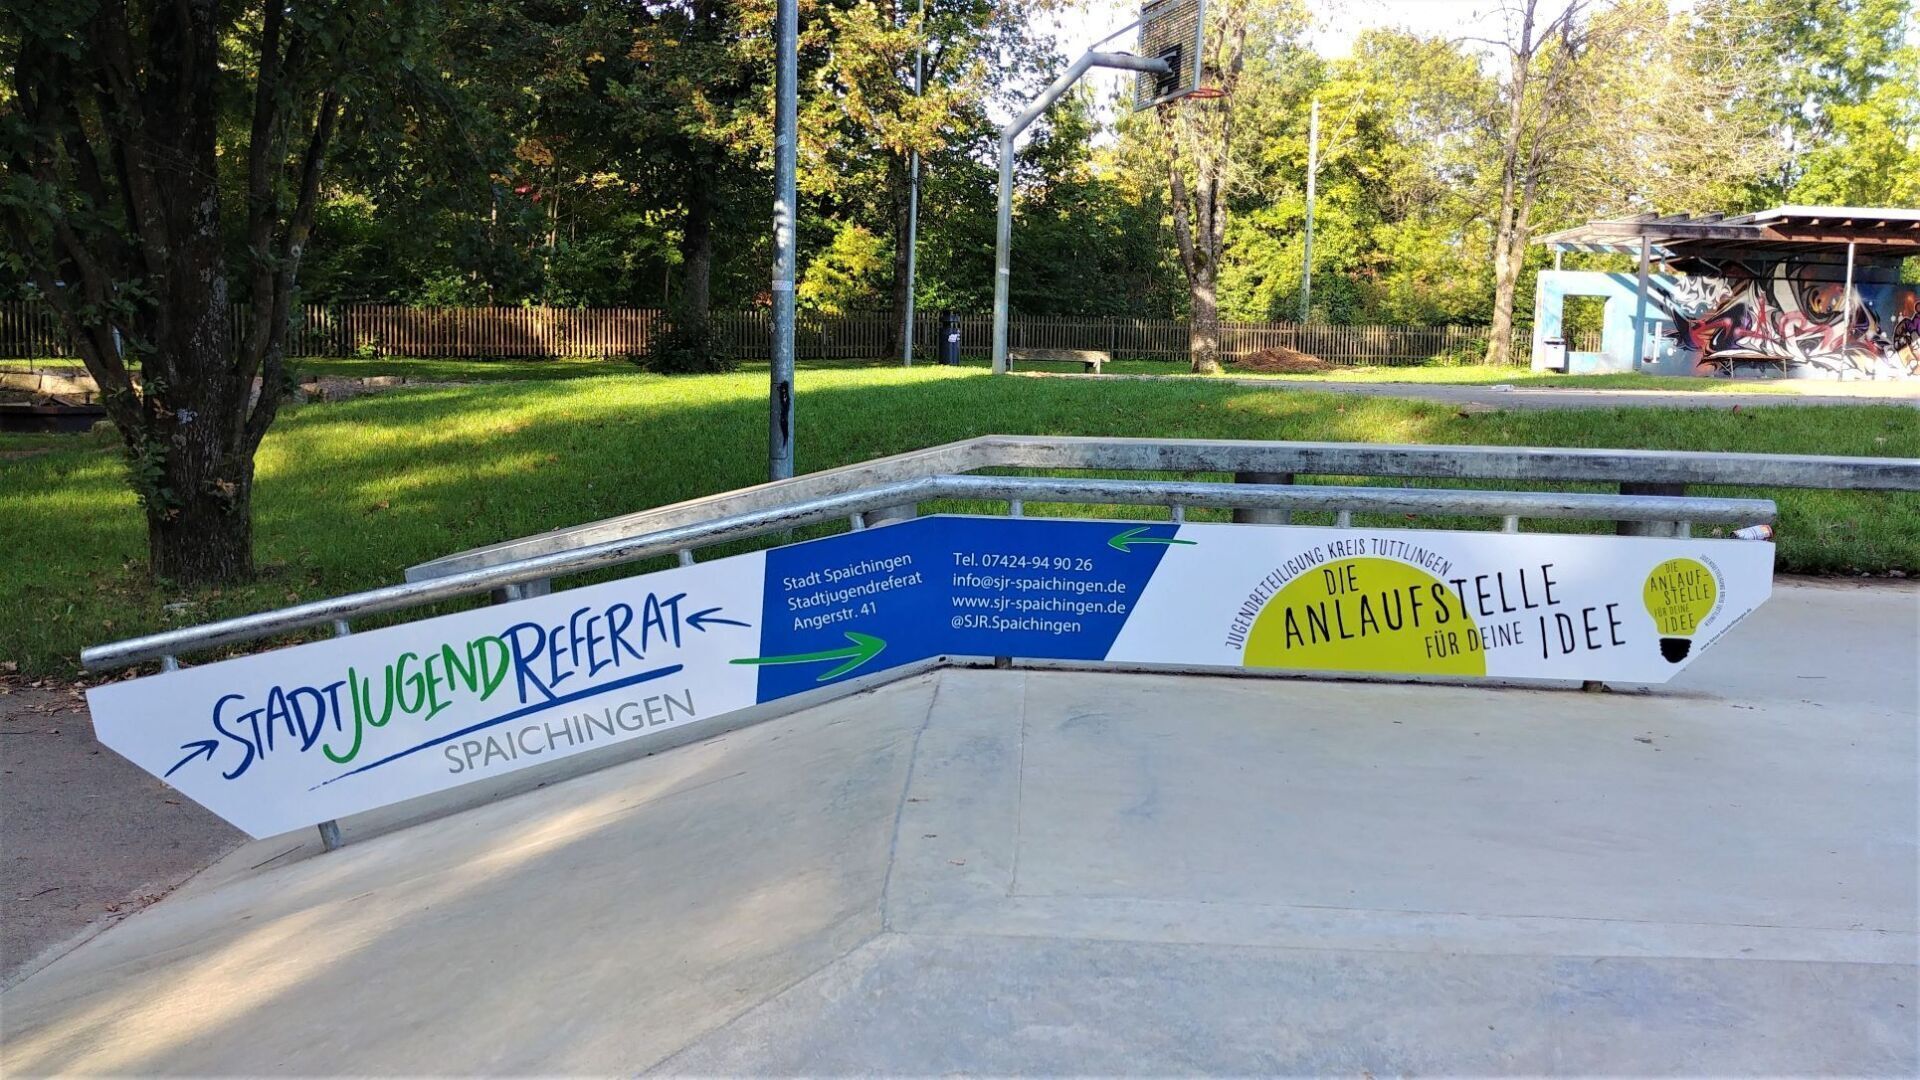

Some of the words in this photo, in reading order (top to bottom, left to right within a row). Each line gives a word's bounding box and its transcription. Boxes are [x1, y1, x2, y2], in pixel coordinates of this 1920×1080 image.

[783, 570, 822, 591] Stadt
[824, 552, 912, 587] Spaichingen
[953, 552, 979, 568] Tel.
[981, 553, 1050, 570] 07424-94
[1053, 556, 1072, 571] 90
[1075, 557, 1093, 571] 26
[1664, 562, 1678, 574] DIE
[787, 571, 923, 612] Stadtjugendreferat
[952, 572, 1126, 594] info@sjr-spaichingen.de
[1225, 546, 1324, 651] JUGENDBETEILIGUNG
[1327, 538, 1366, 560] KREIS
[1371, 538, 1454, 577] TUTTLINGEN
[1323, 564, 1359, 596] DIE
[1650, 569, 1709, 592] ANLAUF-
[1664, 584, 1711, 606] STELLE
[793, 604, 858, 632] Angerstr.
[860, 601, 877, 616] 41
[952, 593, 1126, 616] www.sjr-spaichingen.de
[1284, 563, 1561, 650] ANLAUFSTELLE
[1669, 603, 1690, 616] DEINE
[951, 614, 1081, 634] @SJR.Spaichingen
[1539, 603, 1626, 660] IDEE
[1664, 613, 1696, 633] IDEE
[1424, 629, 1460, 659] FÜR
[1469, 621, 1524, 652] DEINE
[212, 592, 688, 780] STADTJUGENDREFERAT
[443, 688, 696, 775] SPAICHINGEN
